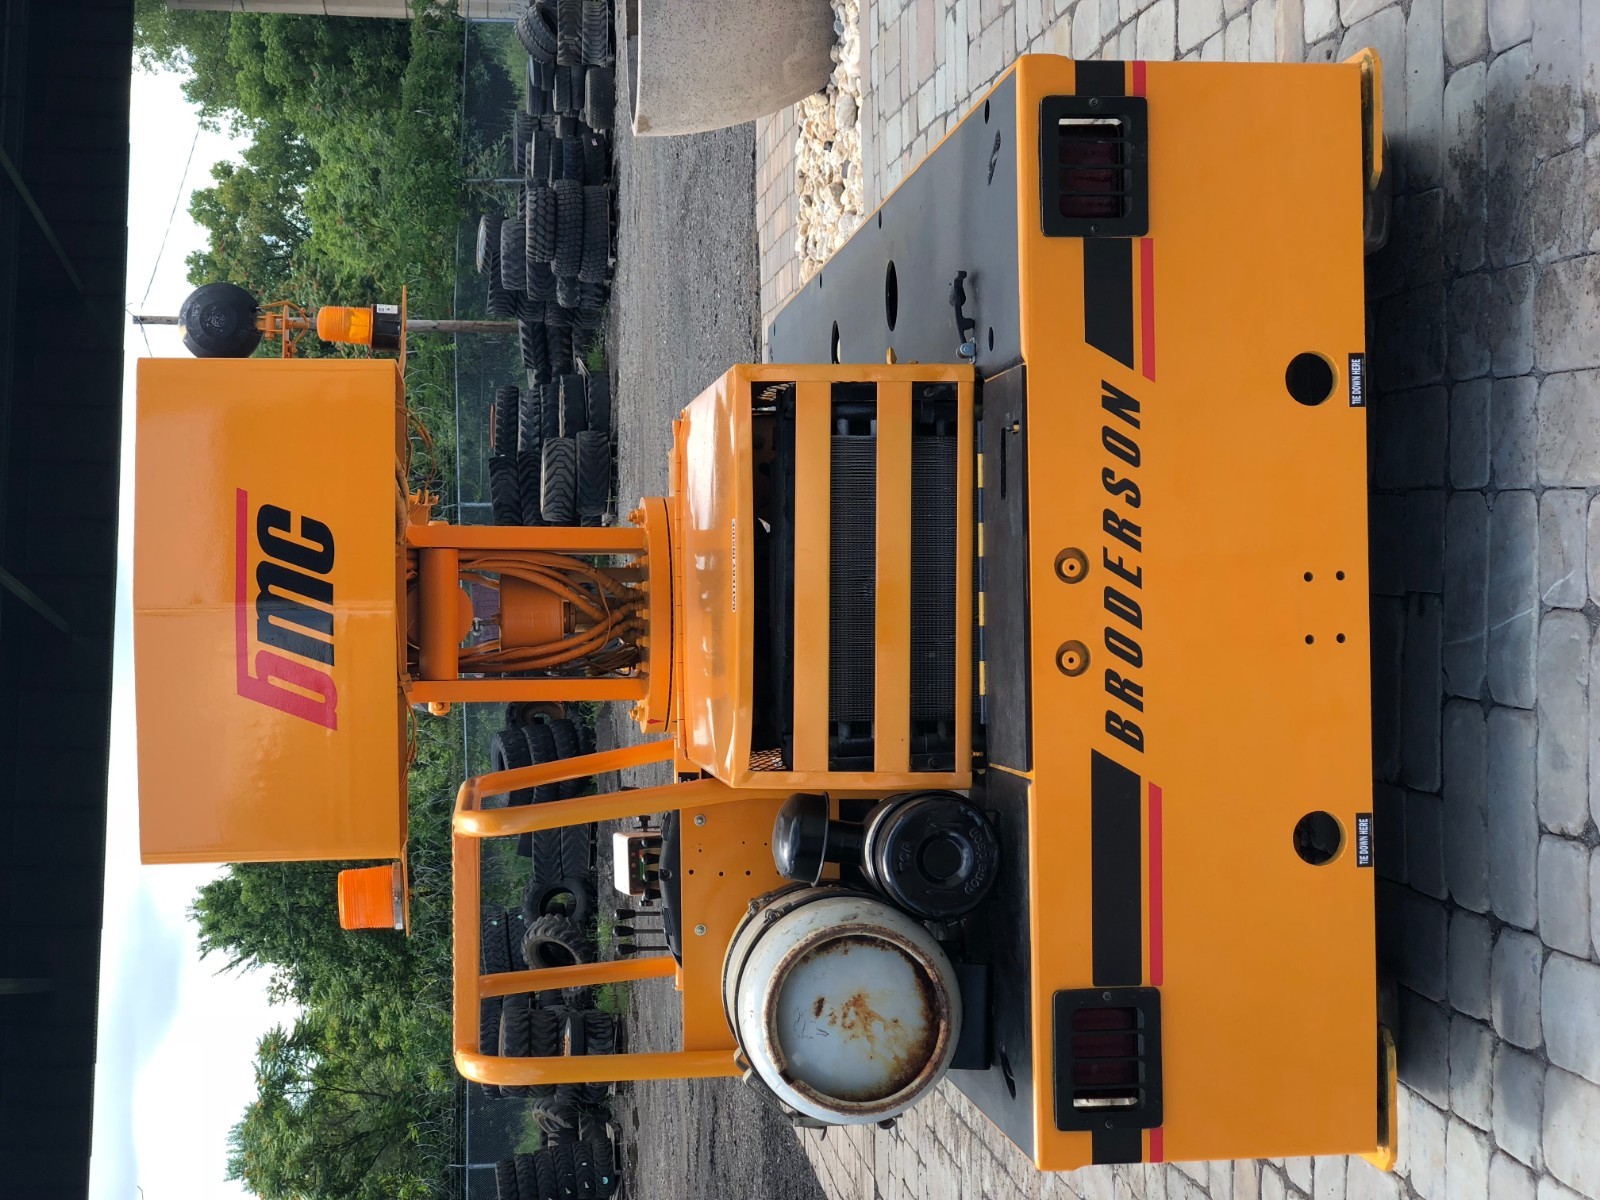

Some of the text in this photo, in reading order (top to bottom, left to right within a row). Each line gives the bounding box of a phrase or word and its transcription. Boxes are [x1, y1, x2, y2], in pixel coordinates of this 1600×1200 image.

[1351, 358, 1362, 405] TIE DOWN HERE
[1101, 379, 1145, 754] BRODERSON
[1358, 818, 1369, 865] TIE DOWN HERE
